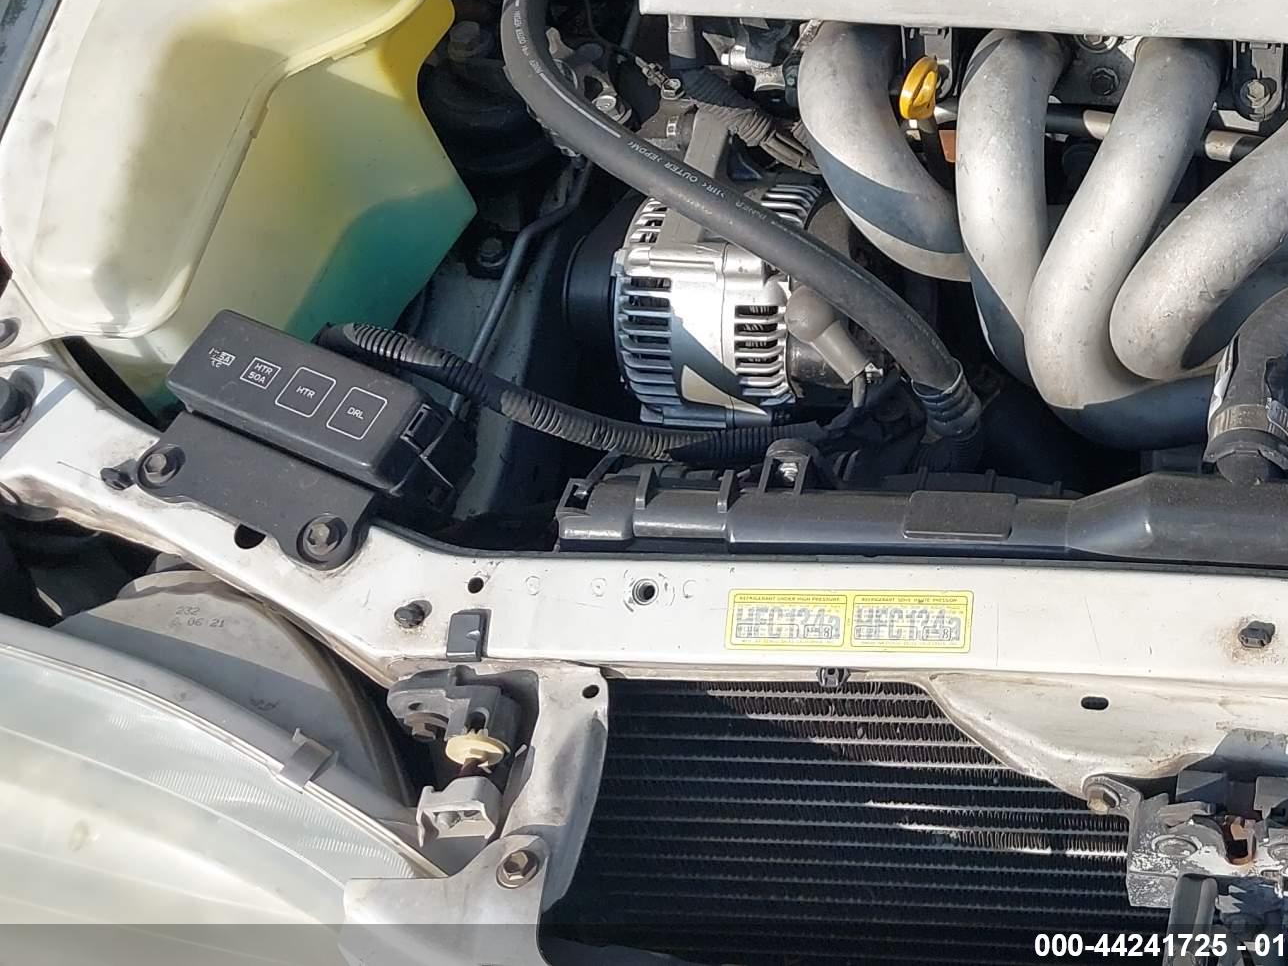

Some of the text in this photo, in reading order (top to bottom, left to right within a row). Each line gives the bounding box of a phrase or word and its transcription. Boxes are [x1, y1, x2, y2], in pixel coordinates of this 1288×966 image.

[254, 362, 274, 376] HTR
[248, 370, 266, 384] 50A
[296, 385, 316, 399] HTR
[347, 406, 365, 420] DRL
